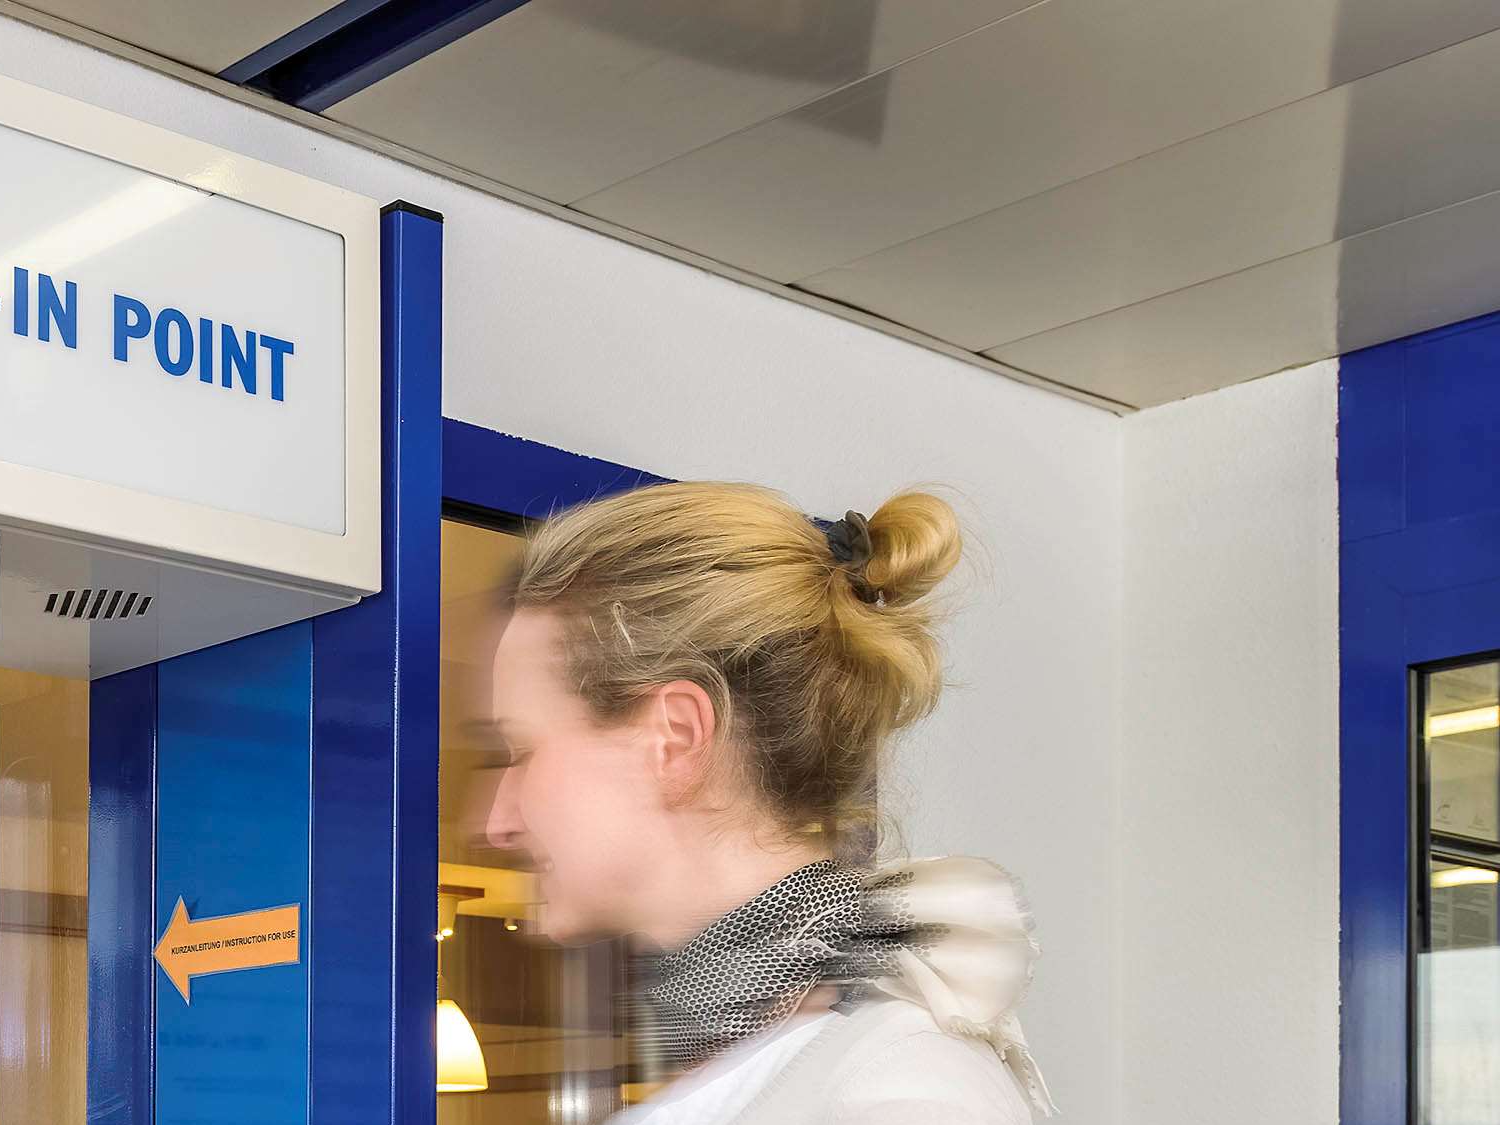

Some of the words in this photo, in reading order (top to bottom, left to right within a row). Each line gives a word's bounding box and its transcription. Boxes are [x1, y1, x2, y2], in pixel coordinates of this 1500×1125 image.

[113, 294, 294, 402] POINT
[172, 940, 220, 955] KURZANLEITUNG
[225, 934, 266, 947] INSTRUCTION
[268, 932, 281, 941] FOR
[282, 930, 295, 939] USE
